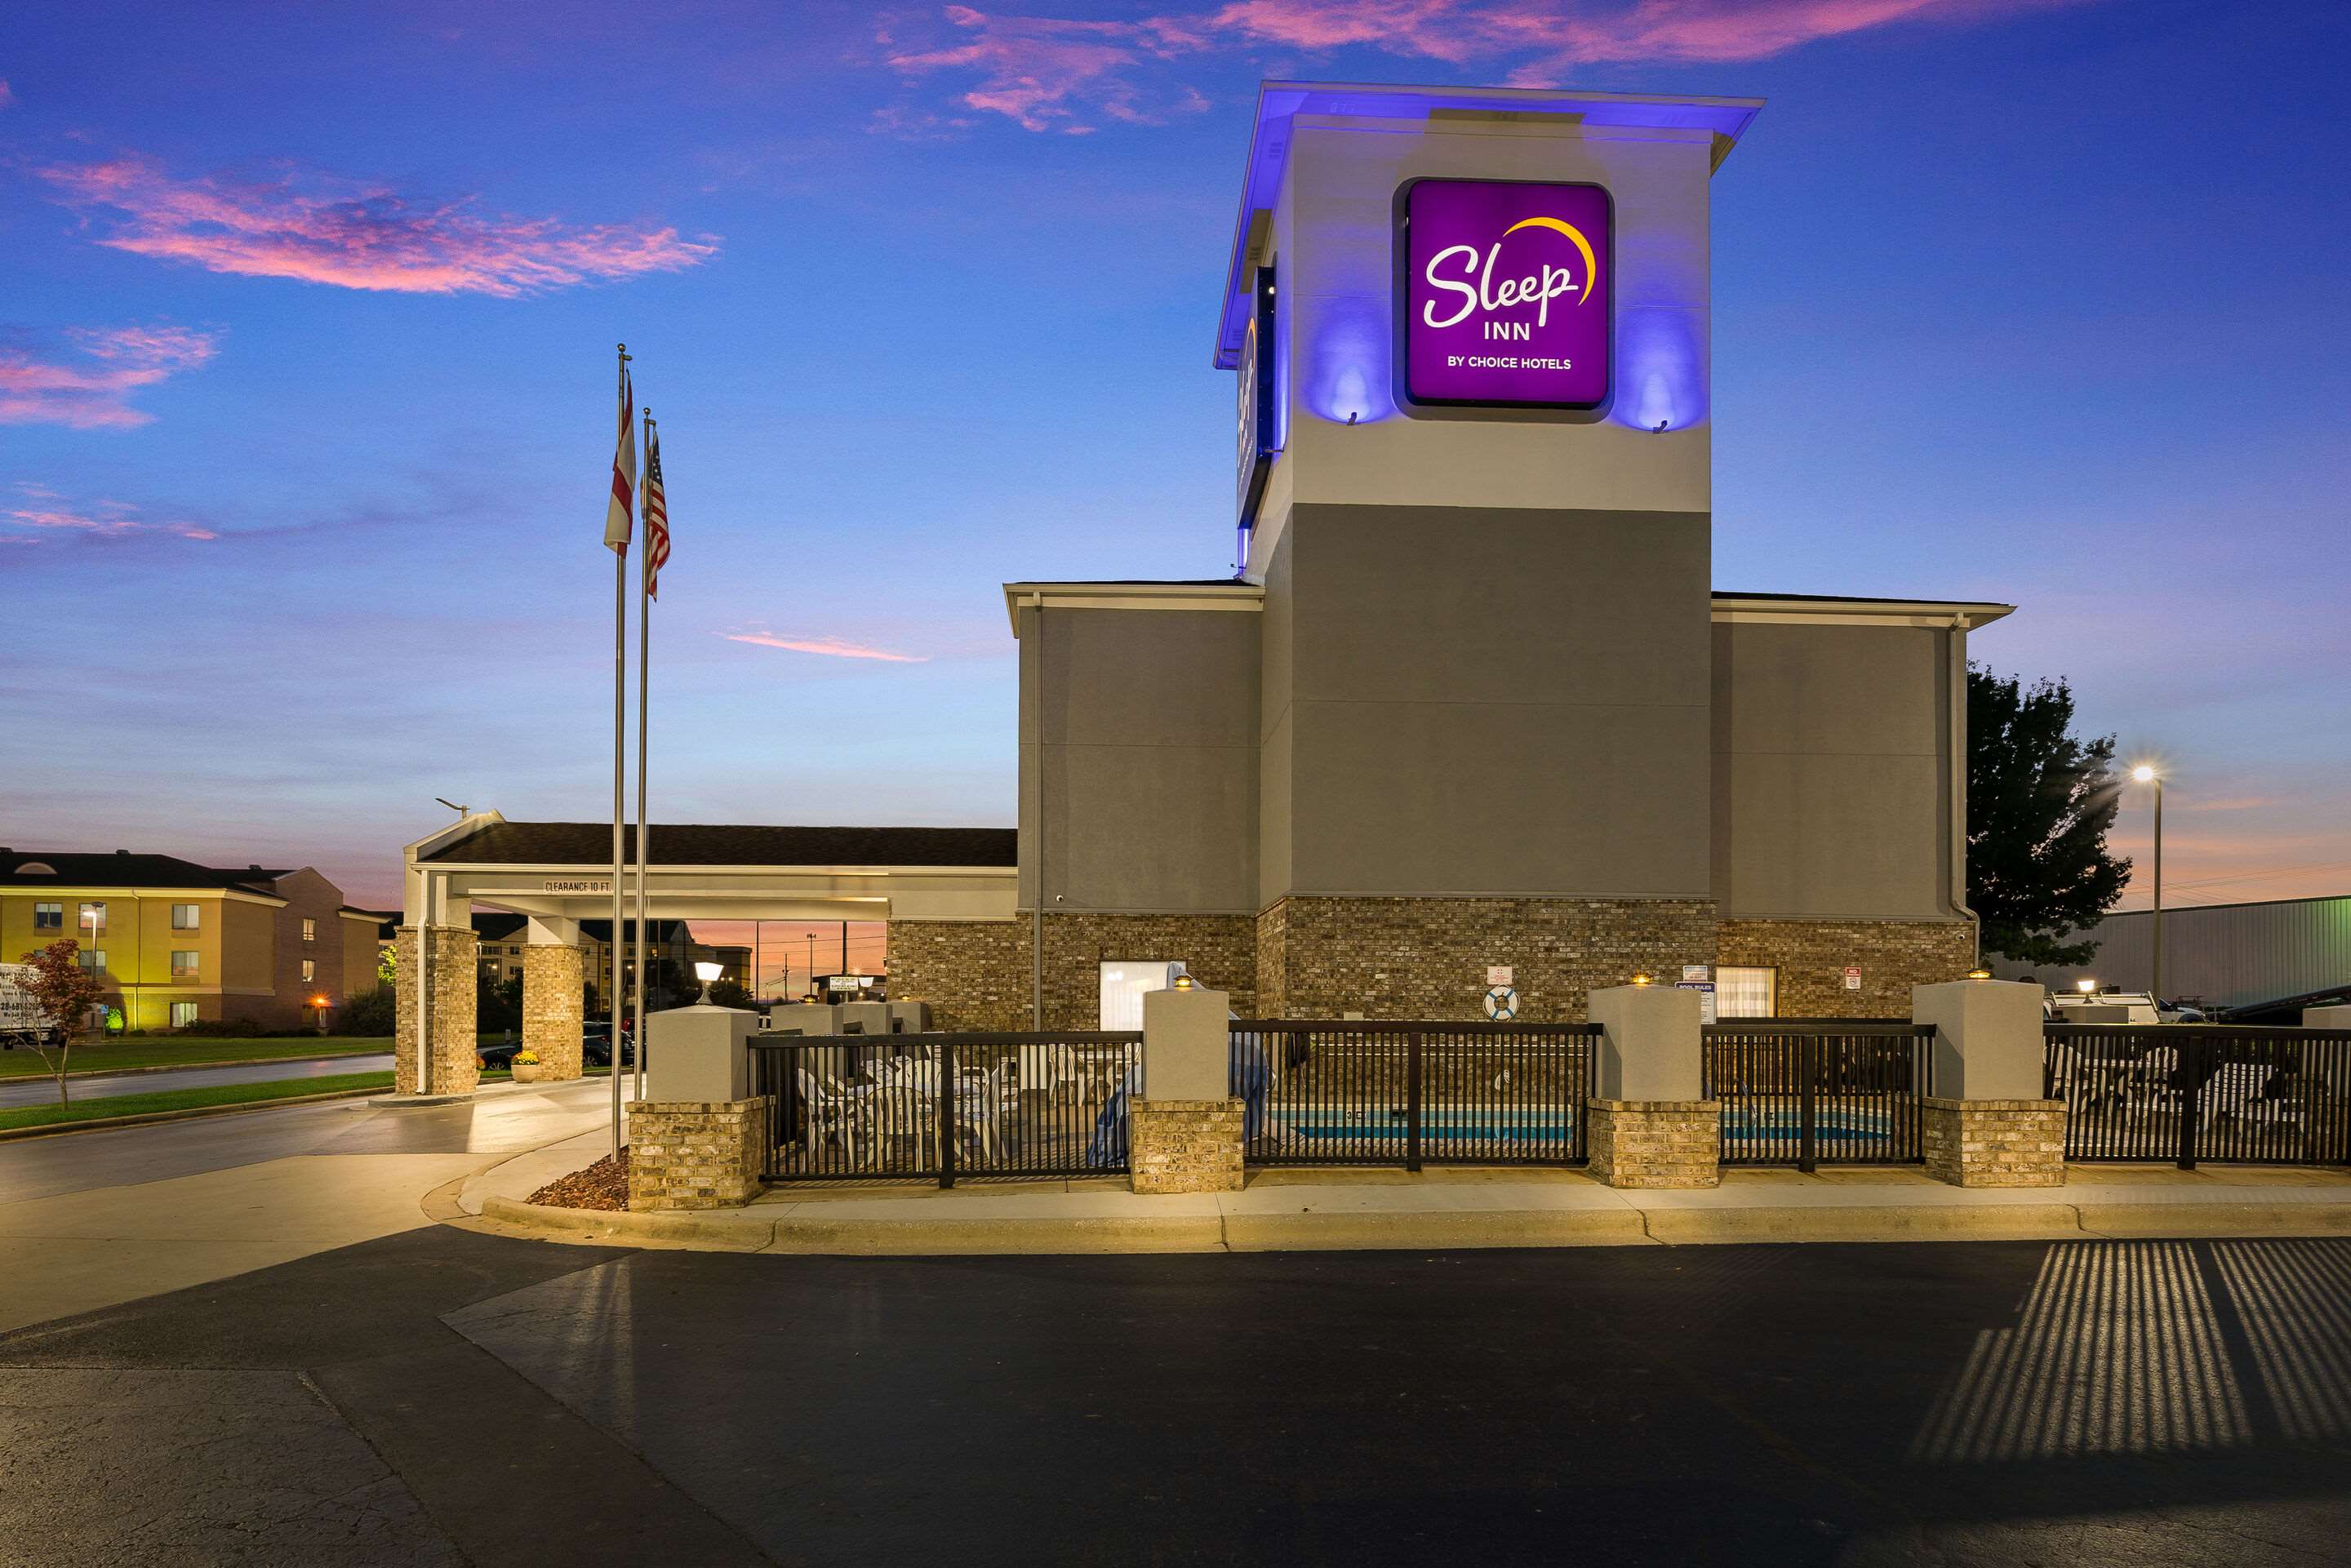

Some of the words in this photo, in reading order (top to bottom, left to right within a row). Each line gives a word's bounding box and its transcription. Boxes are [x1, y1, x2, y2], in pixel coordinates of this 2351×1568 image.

[1424, 242, 1579, 328] Sleep
[1484, 321, 1530, 340] INN
[1447, 356, 1465, 366] BY
[1468, 356, 1518, 368] CHOICE
[1521, 358, 1571, 370] HOTELS
[545, 882, 588, 892] CLEARANCE
[590, 882, 598, 891] 10
[601, 882, 611, 892] FT.
